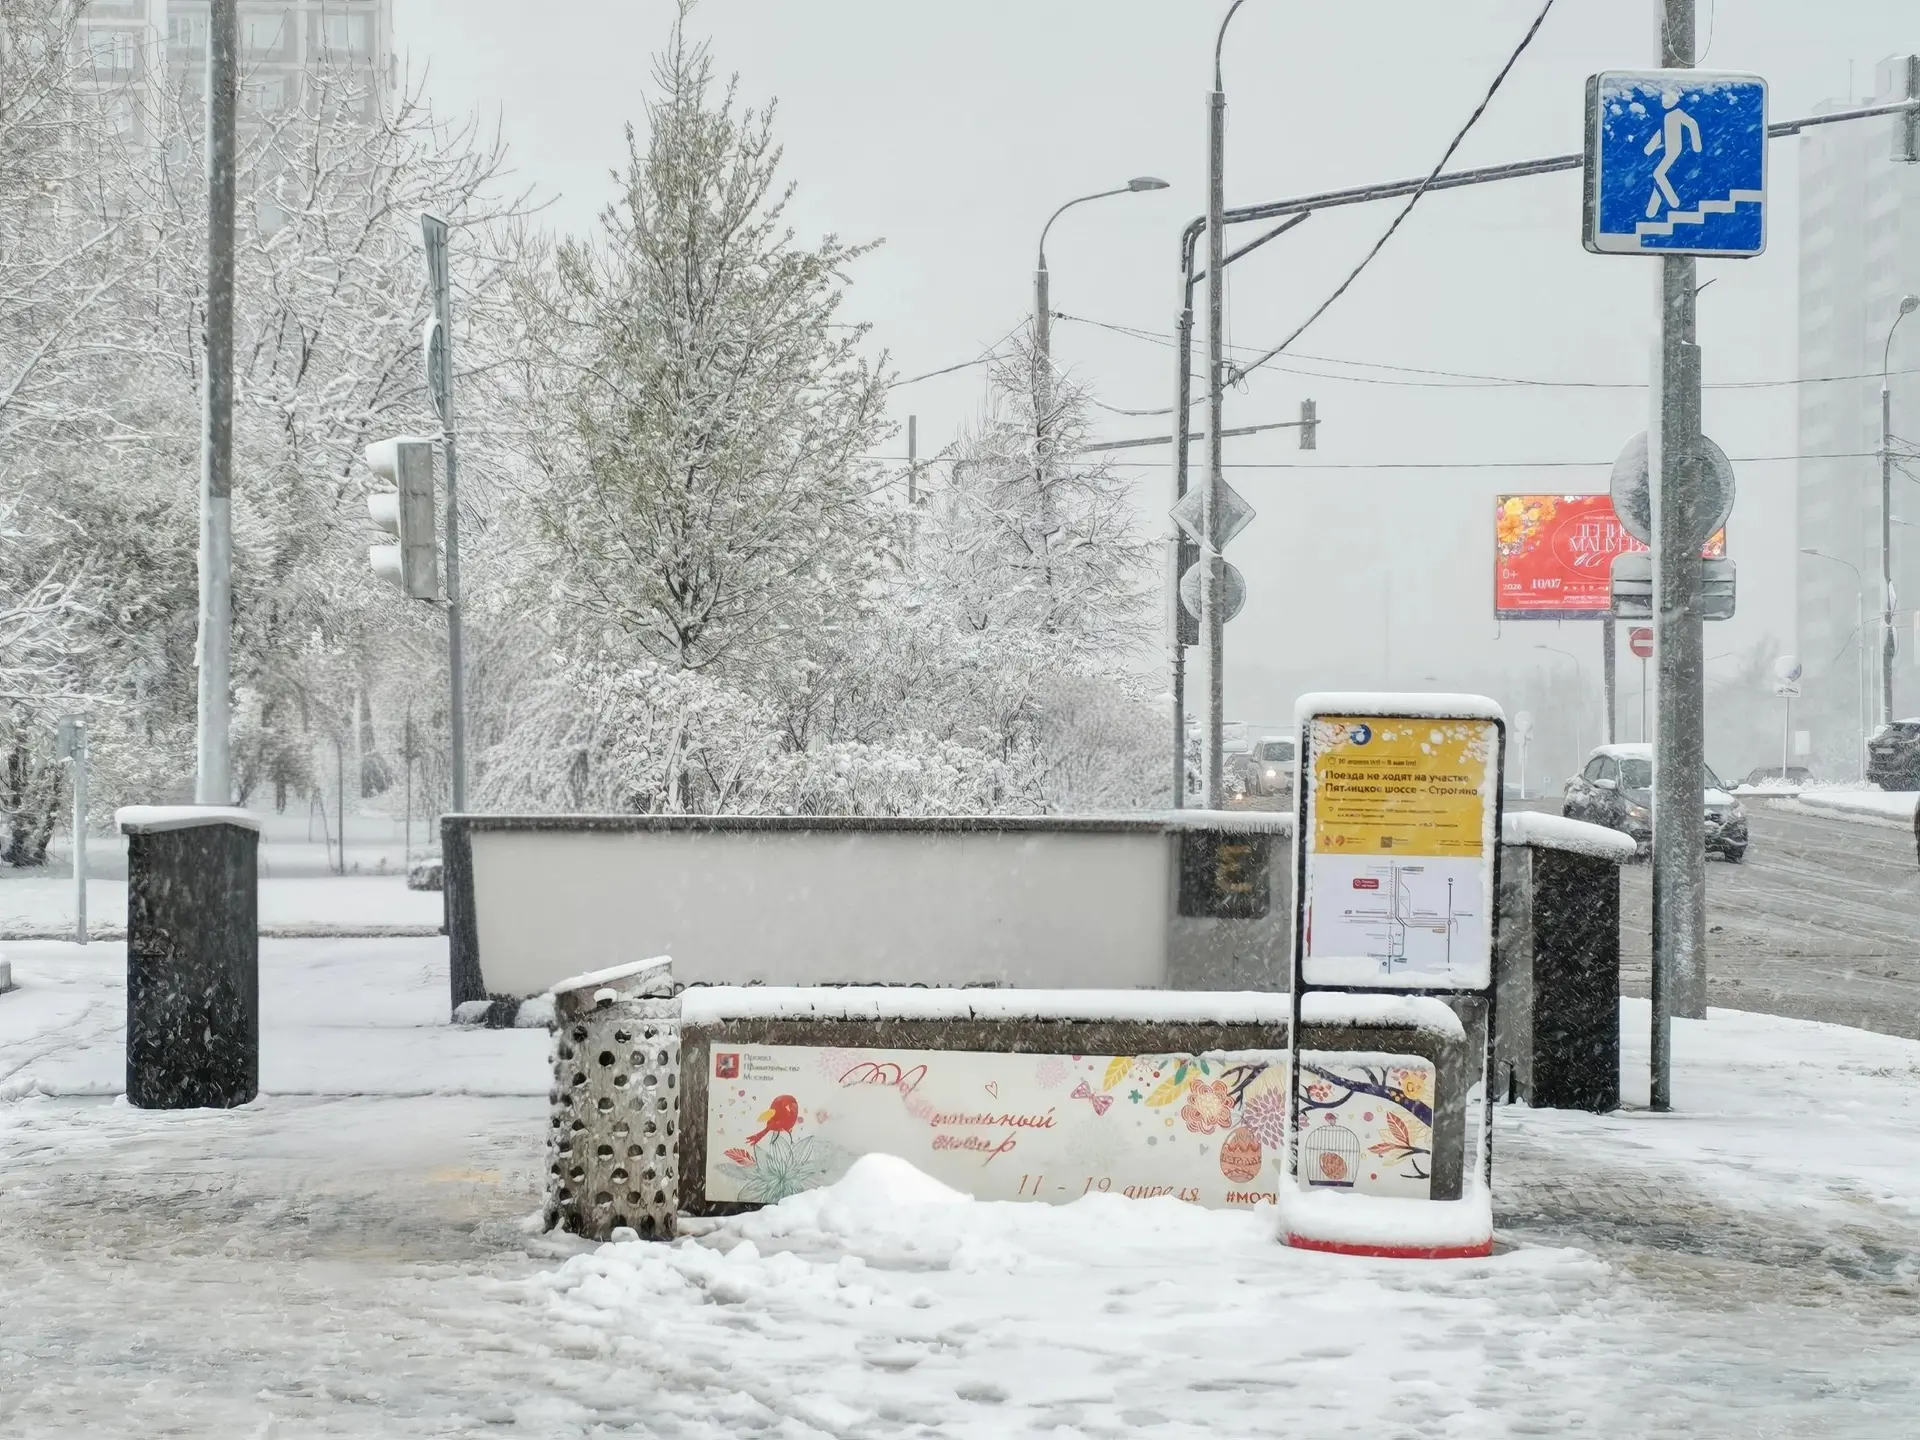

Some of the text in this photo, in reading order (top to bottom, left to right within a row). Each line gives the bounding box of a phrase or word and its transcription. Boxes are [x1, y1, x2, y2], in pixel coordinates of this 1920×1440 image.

[1502, 568, 1519, 579] 0+
[1531, 579, 1562, 590] 10/07
[1325, 770, 1364, 781] Поезда
[1382, 773, 1412, 782] ходят
[1429, 774, 1469, 783] участке
[1325, 783, 1382, 794] Пятницкое
[1385, 786, 1417, 794] шоссе
[1429, 785, 1478, 796] Строгино
[743, 1073, 774, 1081] Москвы
[1018, 1174, 1043, 1197] 11
[1083, 1177, 1112, 1196] 19
